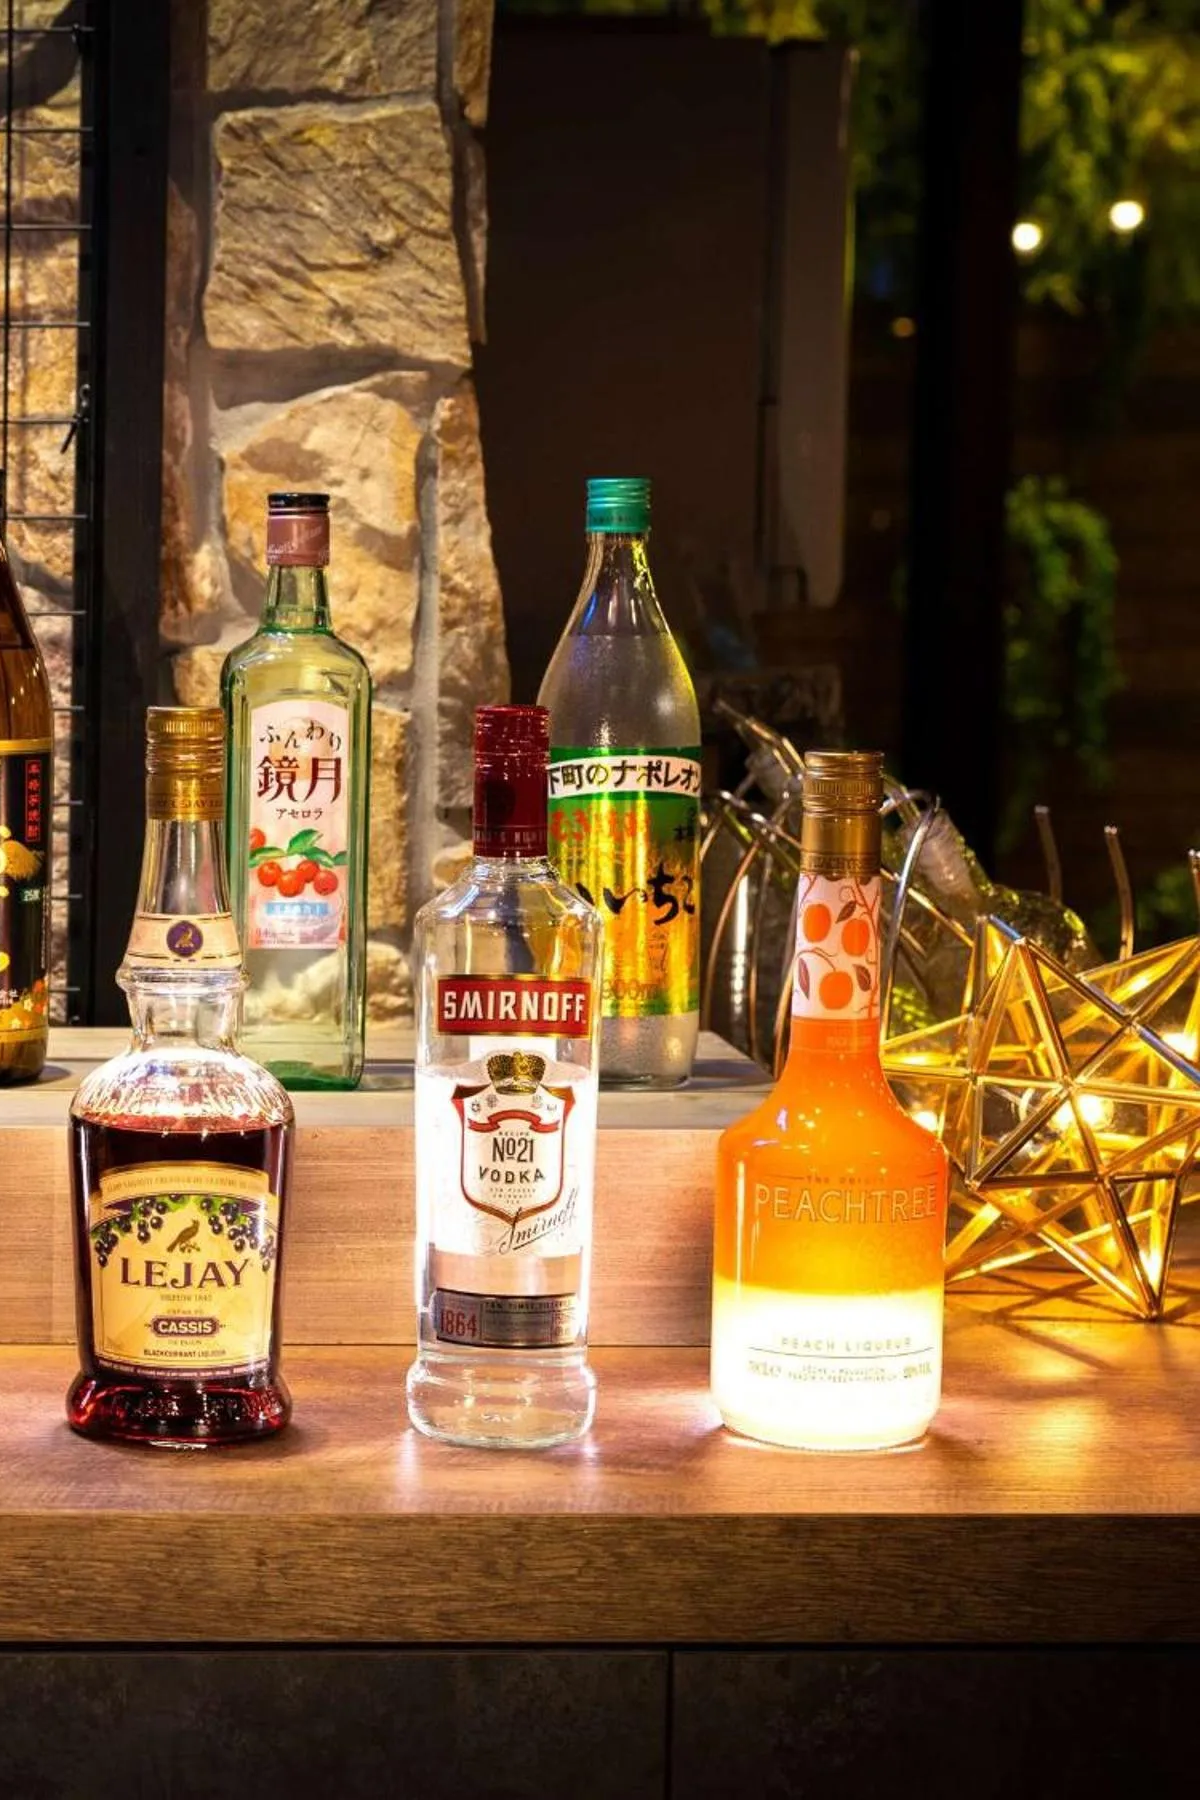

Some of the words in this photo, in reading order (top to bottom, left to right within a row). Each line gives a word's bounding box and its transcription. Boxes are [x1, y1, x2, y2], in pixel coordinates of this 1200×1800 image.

[259, 720, 342, 752] ふんわり
[256, 755, 342, 802] 鏡月
[548, 759, 700, 796] 下町のナポレオ
[275, 807, 324, 821] アセロラ
[443, 990, 586, 1022] SMIRNOFF
[479, 1165, 546, 1184] VODKA
[755, 1183, 938, 1224] PEACHTREE
[121, 1256, 250, 1290] LEJAY
[158, 1321, 213, 1334] CASSIS
[440, 1307, 478, 1338] 1864
[781, 1337, 836, 1351] PEACH
[845, 1336, 912, 1351] LIQUEUR
